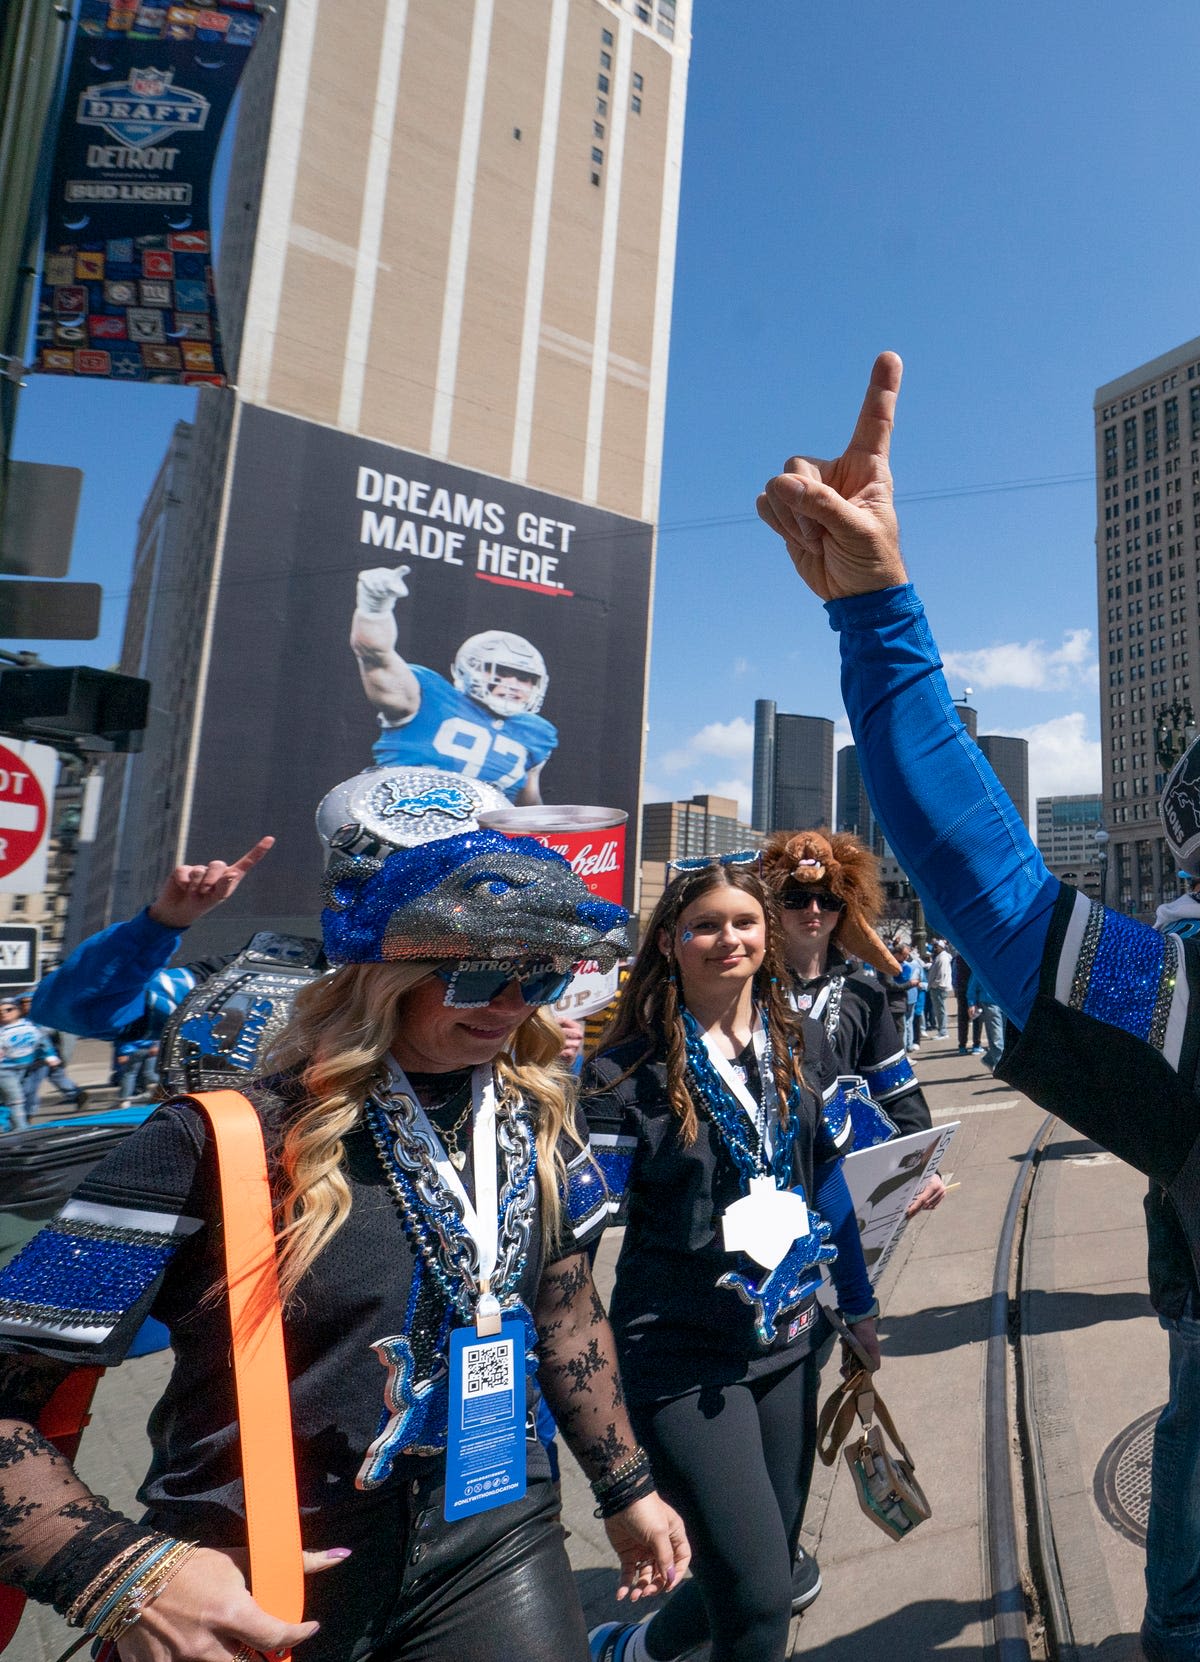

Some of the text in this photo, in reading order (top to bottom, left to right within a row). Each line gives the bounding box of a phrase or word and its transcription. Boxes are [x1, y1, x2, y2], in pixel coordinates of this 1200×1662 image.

[88, 101, 197, 121] DRAFT
[86, 145, 180, 169] DETROIT
[70, 185, 187, 200] BUD LIGHT
[355, 466, 576, 553] DREAMS GET
[359, 510, 565, 590] MADE HERE.
[431, 716, 527, 789] 97
[1163, 801, 1185, 844] LIONS
[554, 990, 591, 1012] UP
[922, 1128, 956, 1183] TRUST
